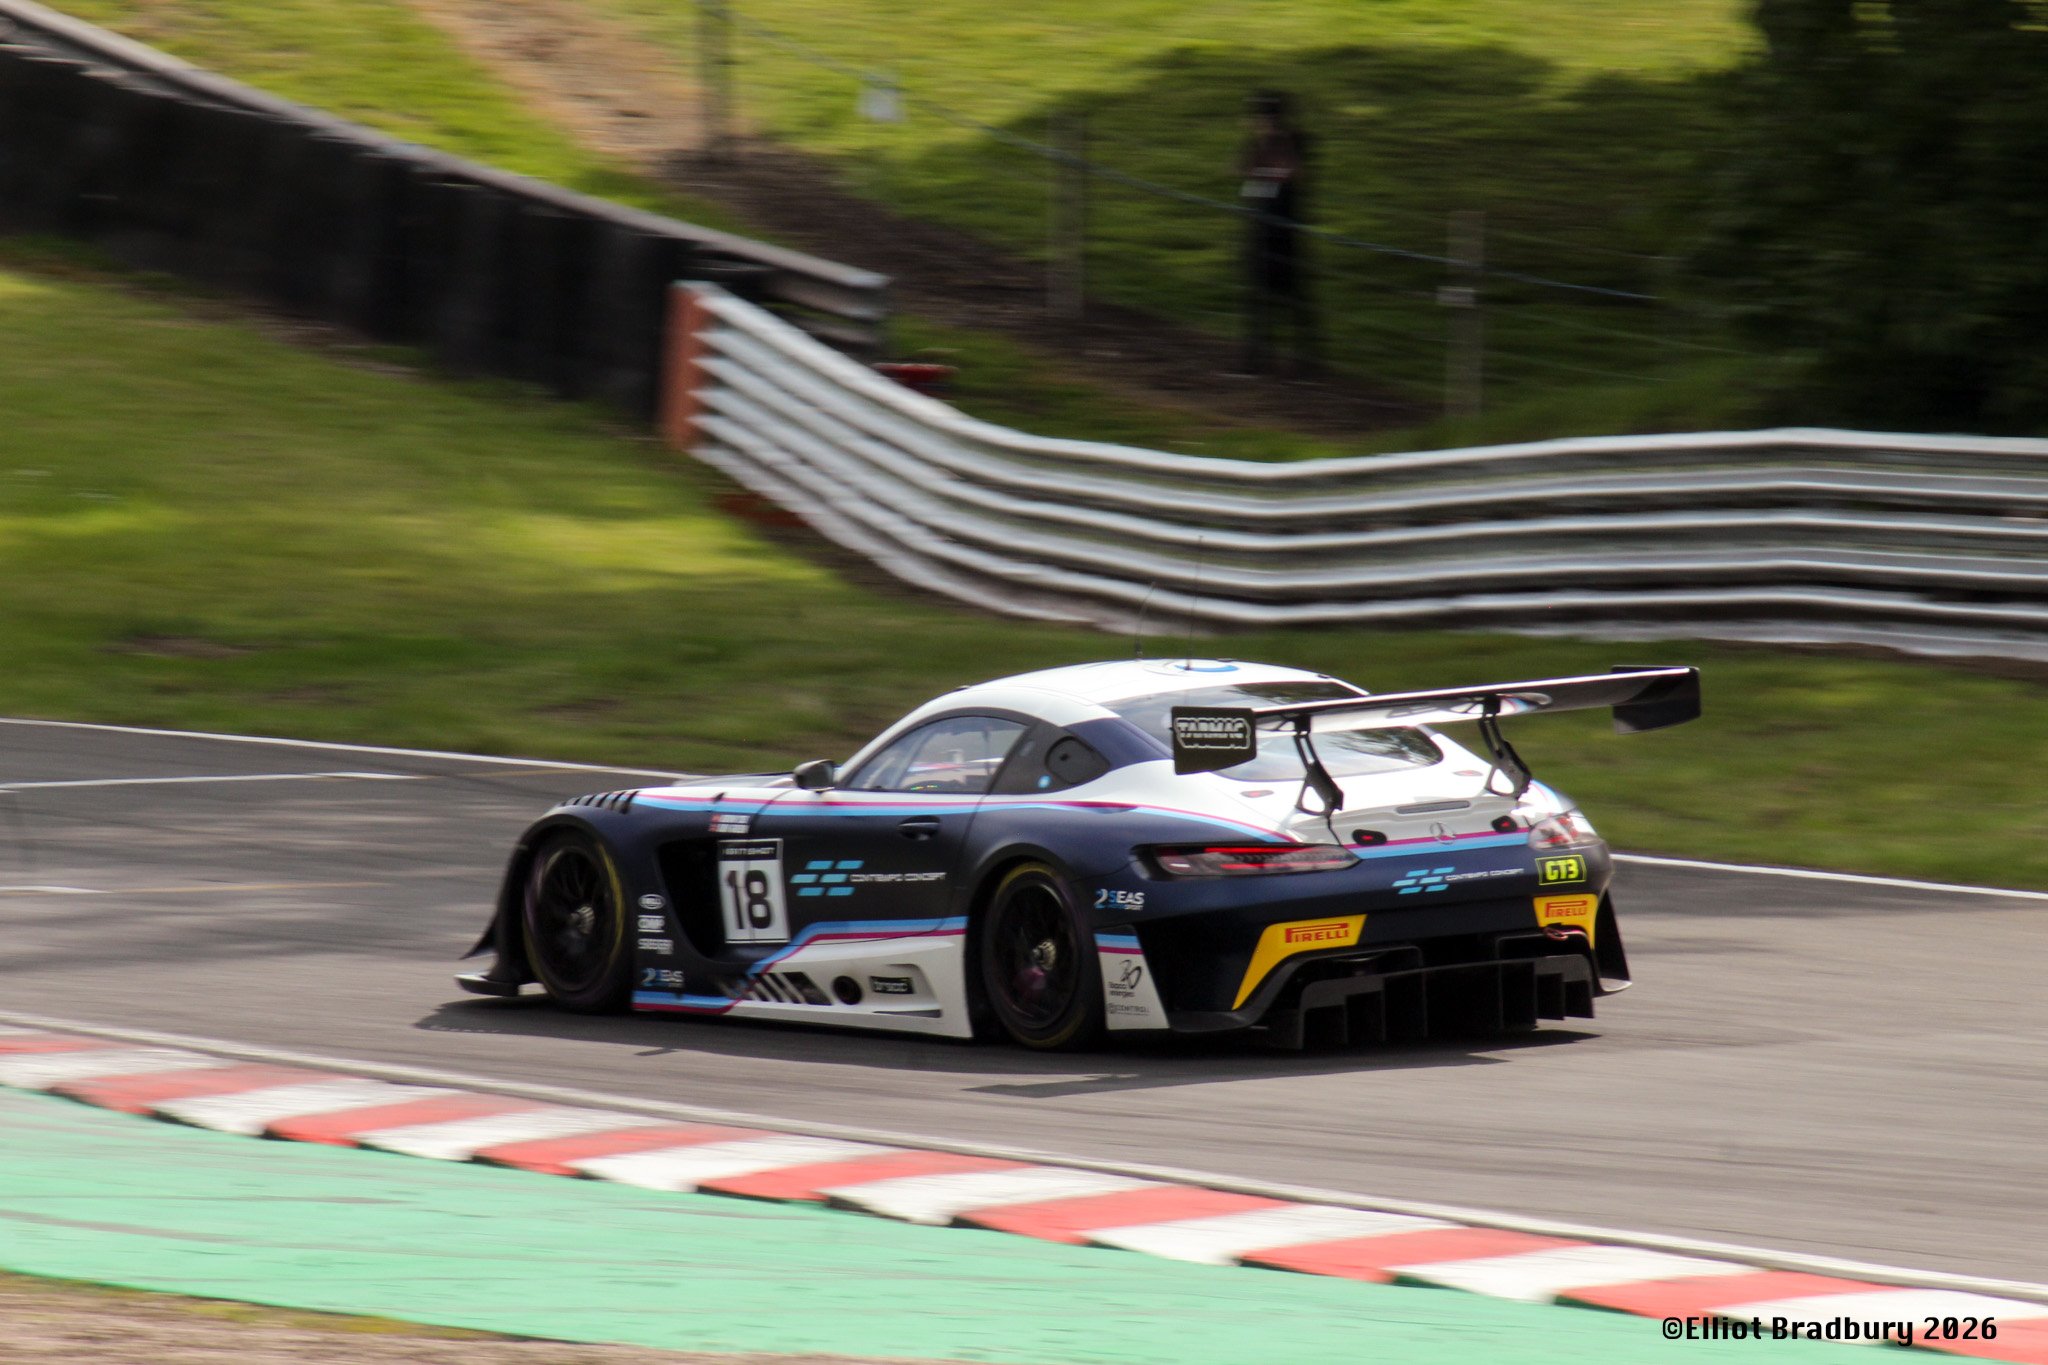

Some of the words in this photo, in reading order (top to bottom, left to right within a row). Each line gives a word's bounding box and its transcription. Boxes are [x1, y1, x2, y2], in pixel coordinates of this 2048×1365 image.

[1177, 721, 1244, 732] TARMAC
[1545, 859, 1579, 880] GT3
[725, 869, 772, 930] 18
[1545, 899, 1588, 919] PIRELLI
[1285, 922, 1350, 944] PIRELLI
